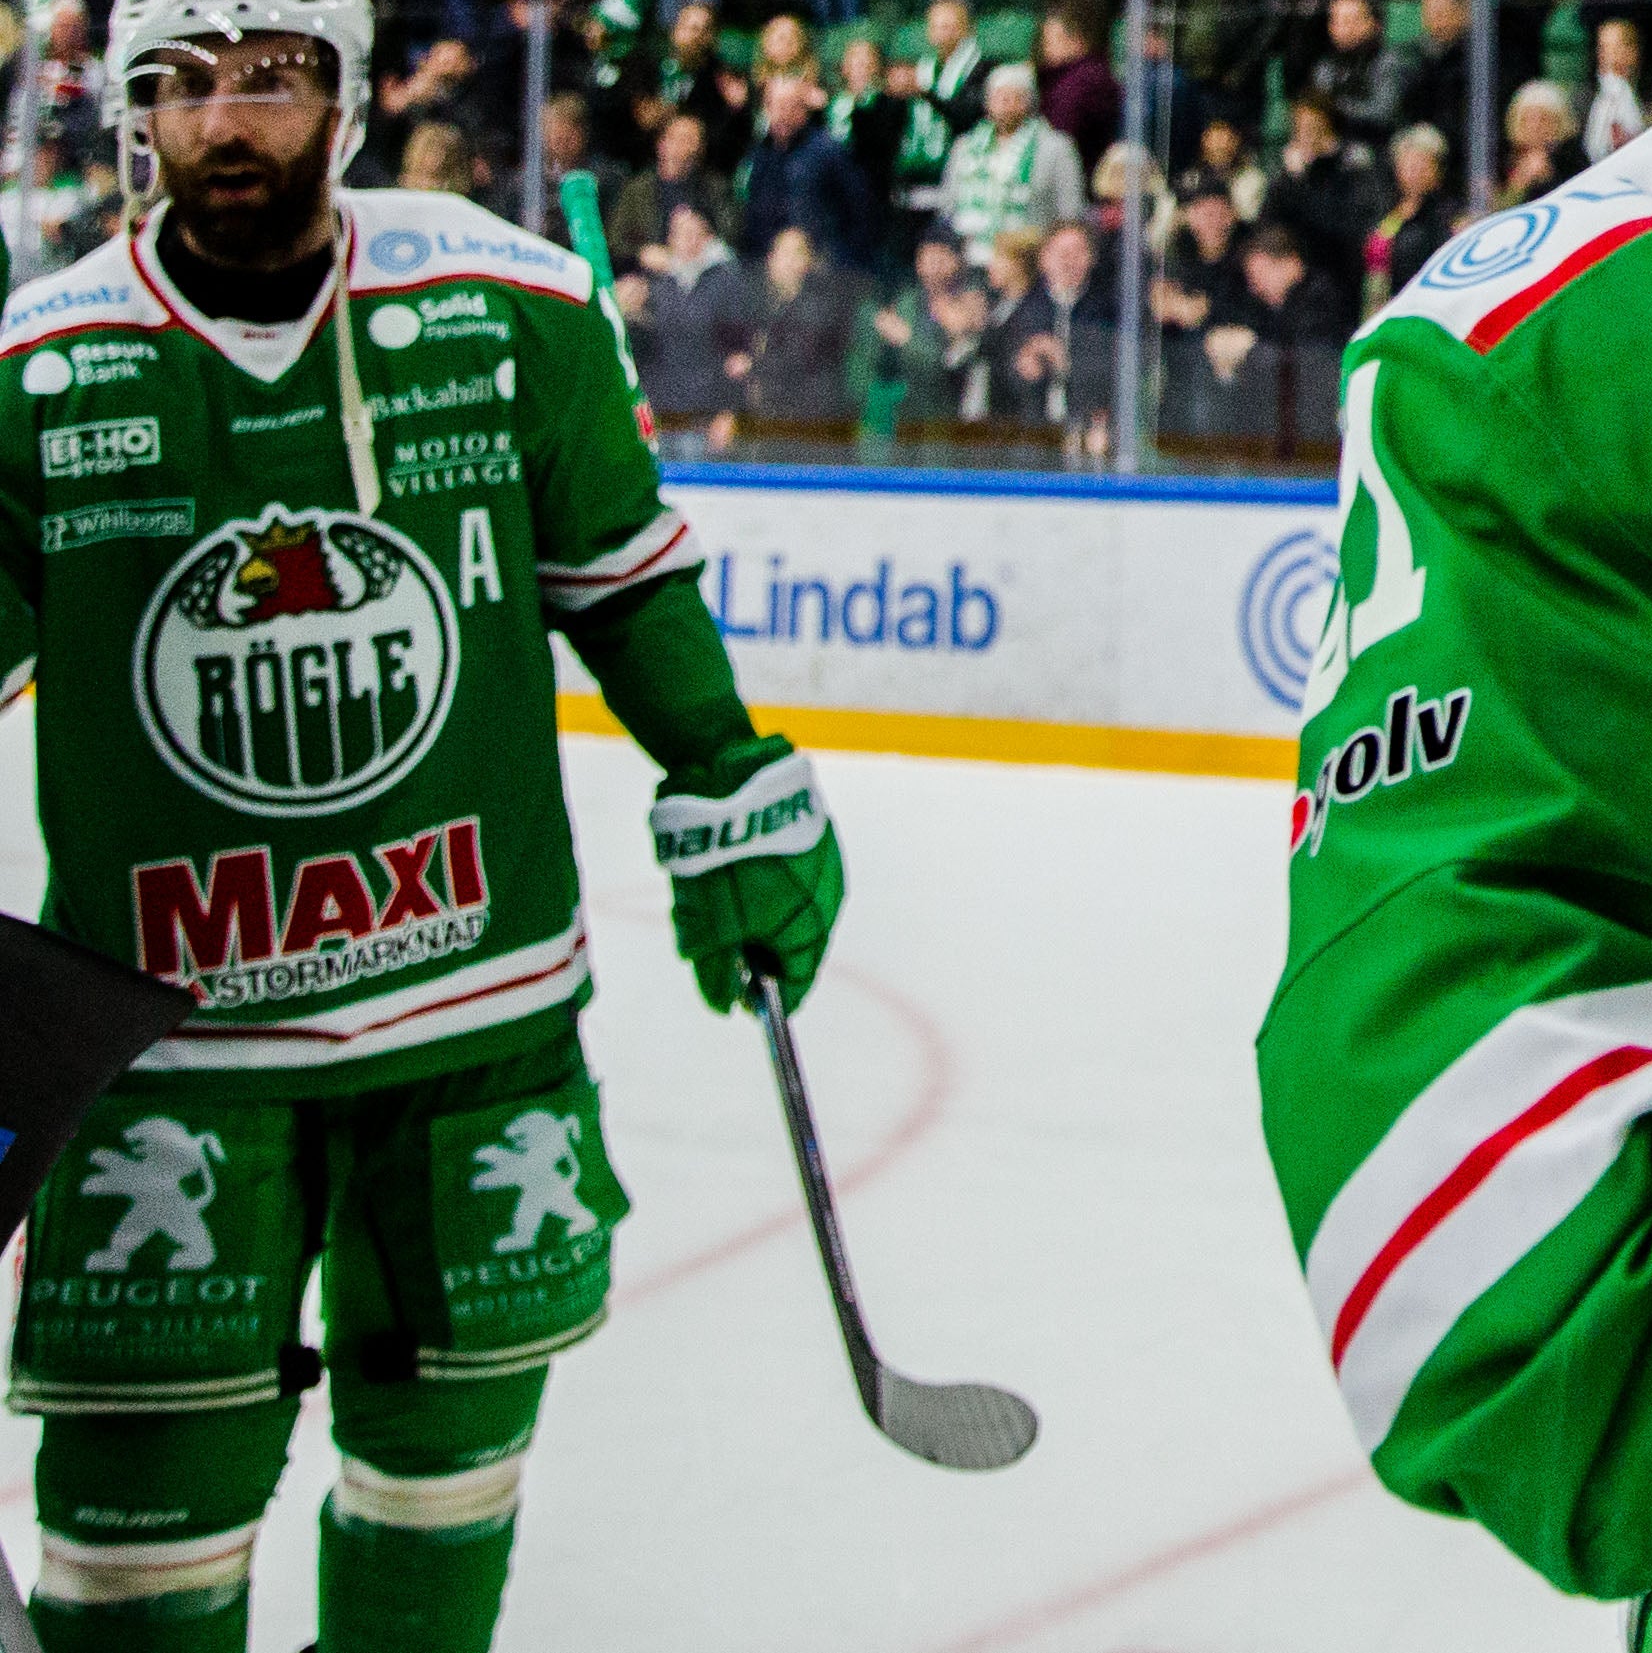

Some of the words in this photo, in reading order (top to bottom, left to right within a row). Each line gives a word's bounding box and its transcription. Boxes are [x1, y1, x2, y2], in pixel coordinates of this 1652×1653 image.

[458, 508, 502, 608] A
[720, 553, 998, 652] Lindab
[131, 815, 489, 980] MAXI
